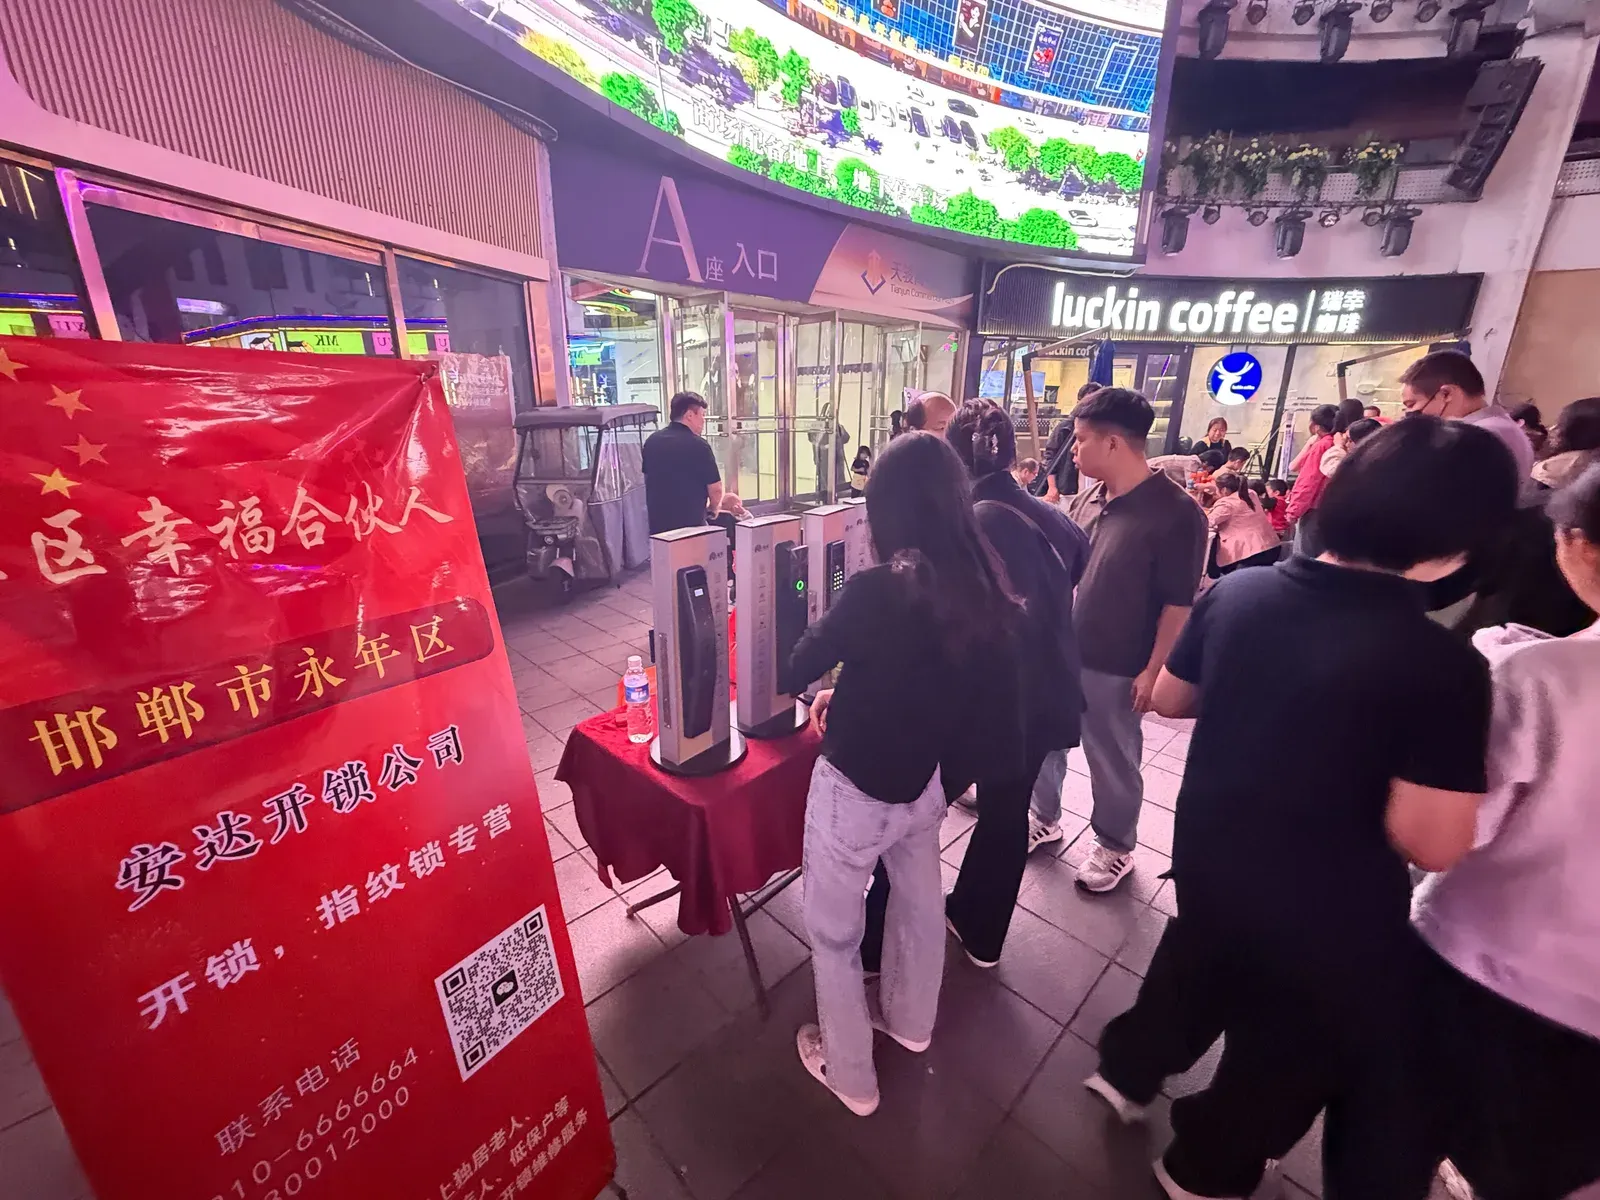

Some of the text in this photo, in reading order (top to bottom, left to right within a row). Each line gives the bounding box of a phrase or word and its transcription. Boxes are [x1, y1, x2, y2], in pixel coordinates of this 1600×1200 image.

[1051, 281, 1298, 334] luckin coffee
[1314, 312, 1362, 334] 咖啡
[1319, 290, 1367, 312] 瑞幸
[0, 485, 455, 585] 区幸福合伙人
[29, 615, 455, 776] 邯郸市永年区
[115, 723, 467, 913] 安达开锁公司
[214, 1037, 361, 1156] 联系电话
